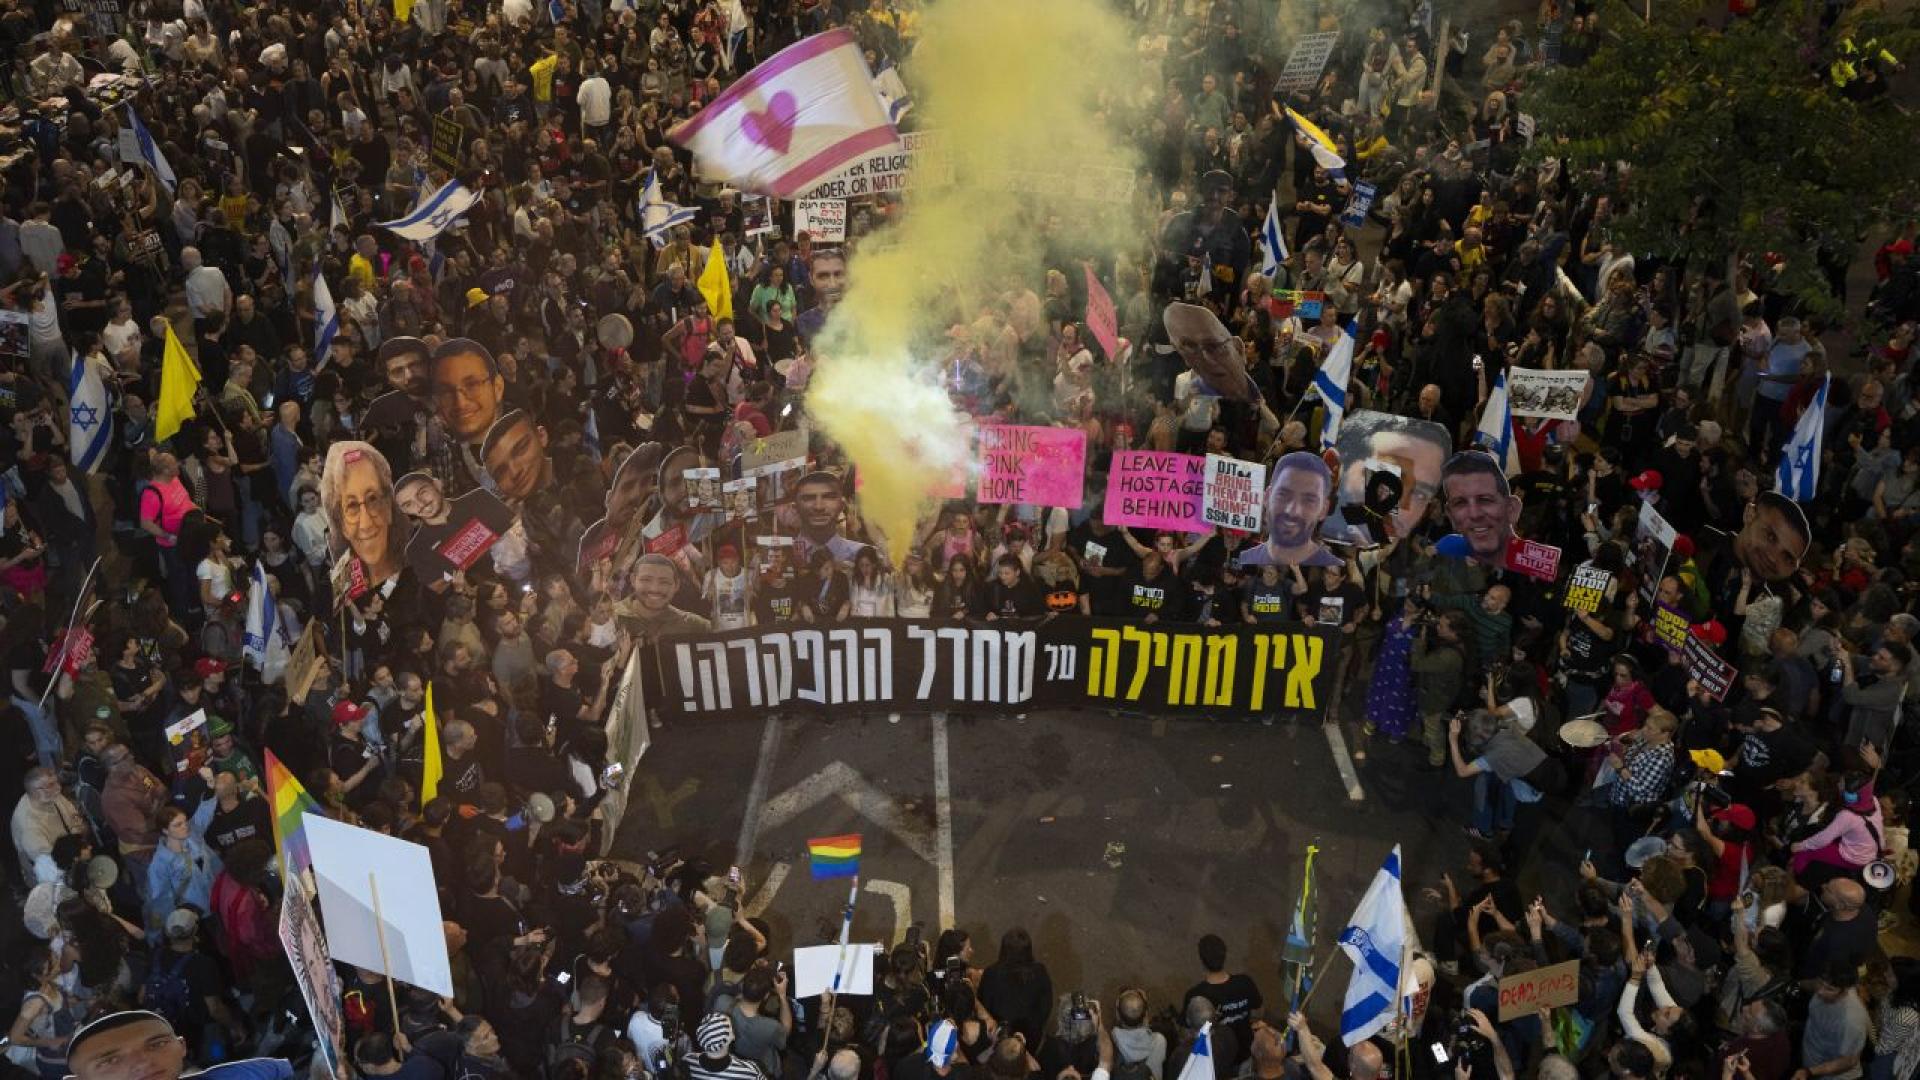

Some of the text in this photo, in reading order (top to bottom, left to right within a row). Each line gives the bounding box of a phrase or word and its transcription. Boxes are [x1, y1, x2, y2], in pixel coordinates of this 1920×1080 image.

[851, 177, 868, 193] OR
[984, 428, 1041, 453] BRING
[983, 454, 1026, 476] PINK
[1120, 455, 1178, 474] LEAVE
[983, 478, 1026, 501] HOME
[1120, 476, 1204, 496] HOSTAGE
[1214, 473, 1252, 490] BRING
[1206, 483, 1260, 505] THEM ALL
[1122, 498, 1197, 519] BEHIND
[1212, 497, 1252, 516] HOME!
[1205, 508, 1257, 529] SSN & ID
[675, 627, 894, 712] ההפקרה!
[907, 624, 1036, 704] מחדל
[1043, 642, 1077, 682] על
[1087, 624, 1239, 706] מחילה
[1250, 634, 1324, 712] אין
